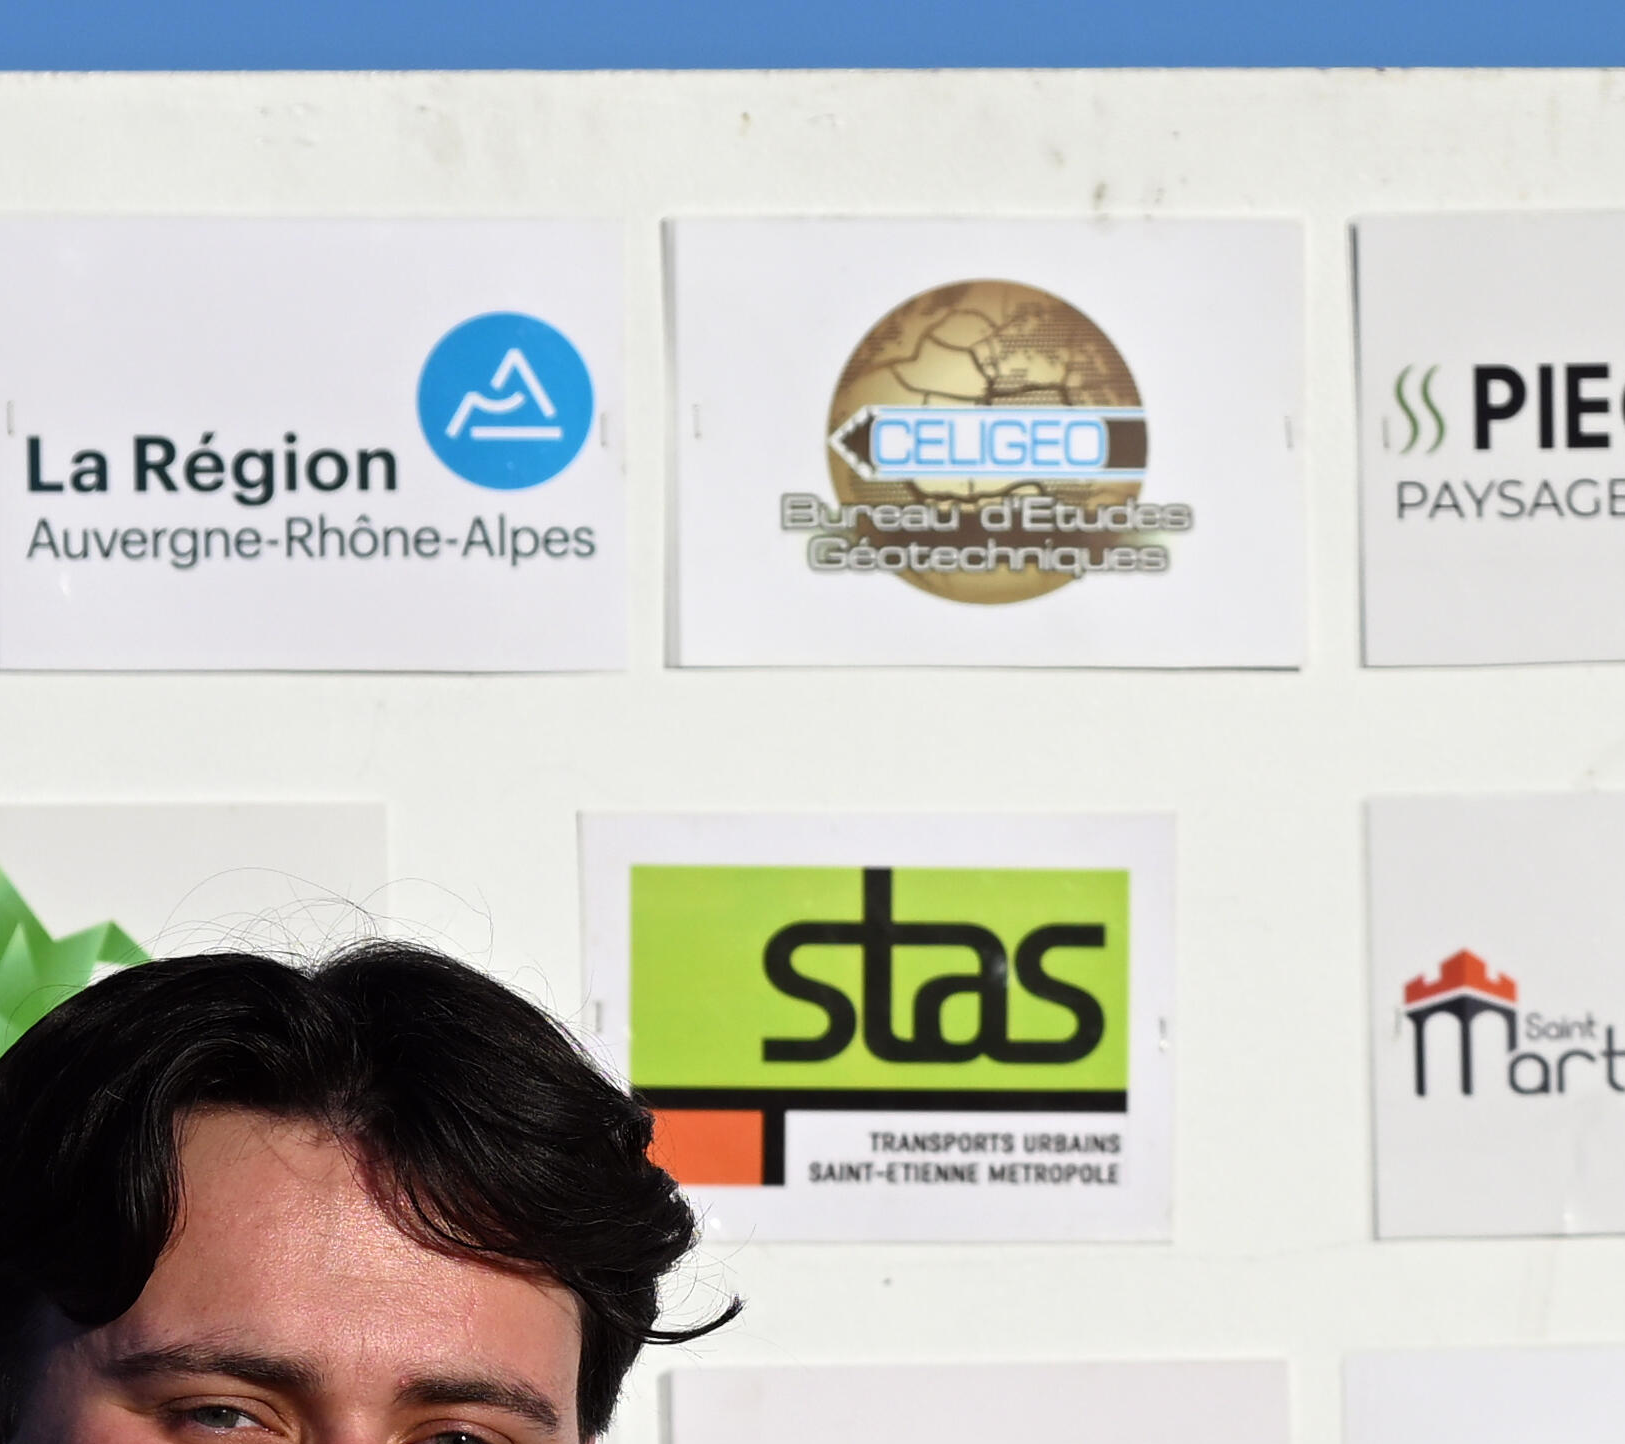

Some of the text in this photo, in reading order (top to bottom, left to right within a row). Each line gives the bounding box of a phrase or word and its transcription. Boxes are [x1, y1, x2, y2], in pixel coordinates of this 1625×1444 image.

[871, 415, 1106, 472] CELIGEO
[27, 432, 399, 507] La Région
[781, 493, 960, 531] Bureau
[27, 512, 598, 570] Auvergne-Rhône-Alpes
[808, 534, 1171, 578] Géotechniques
[762, 864, 1107, 1064] stas
[1525, 1010, 1598, 1042] Saint
[868, 1131, 1123, 1156] TRANSPORTS URBAINS
[807, 1161, 1122, 1187] SAINT-ETIENNE METROPOLE
